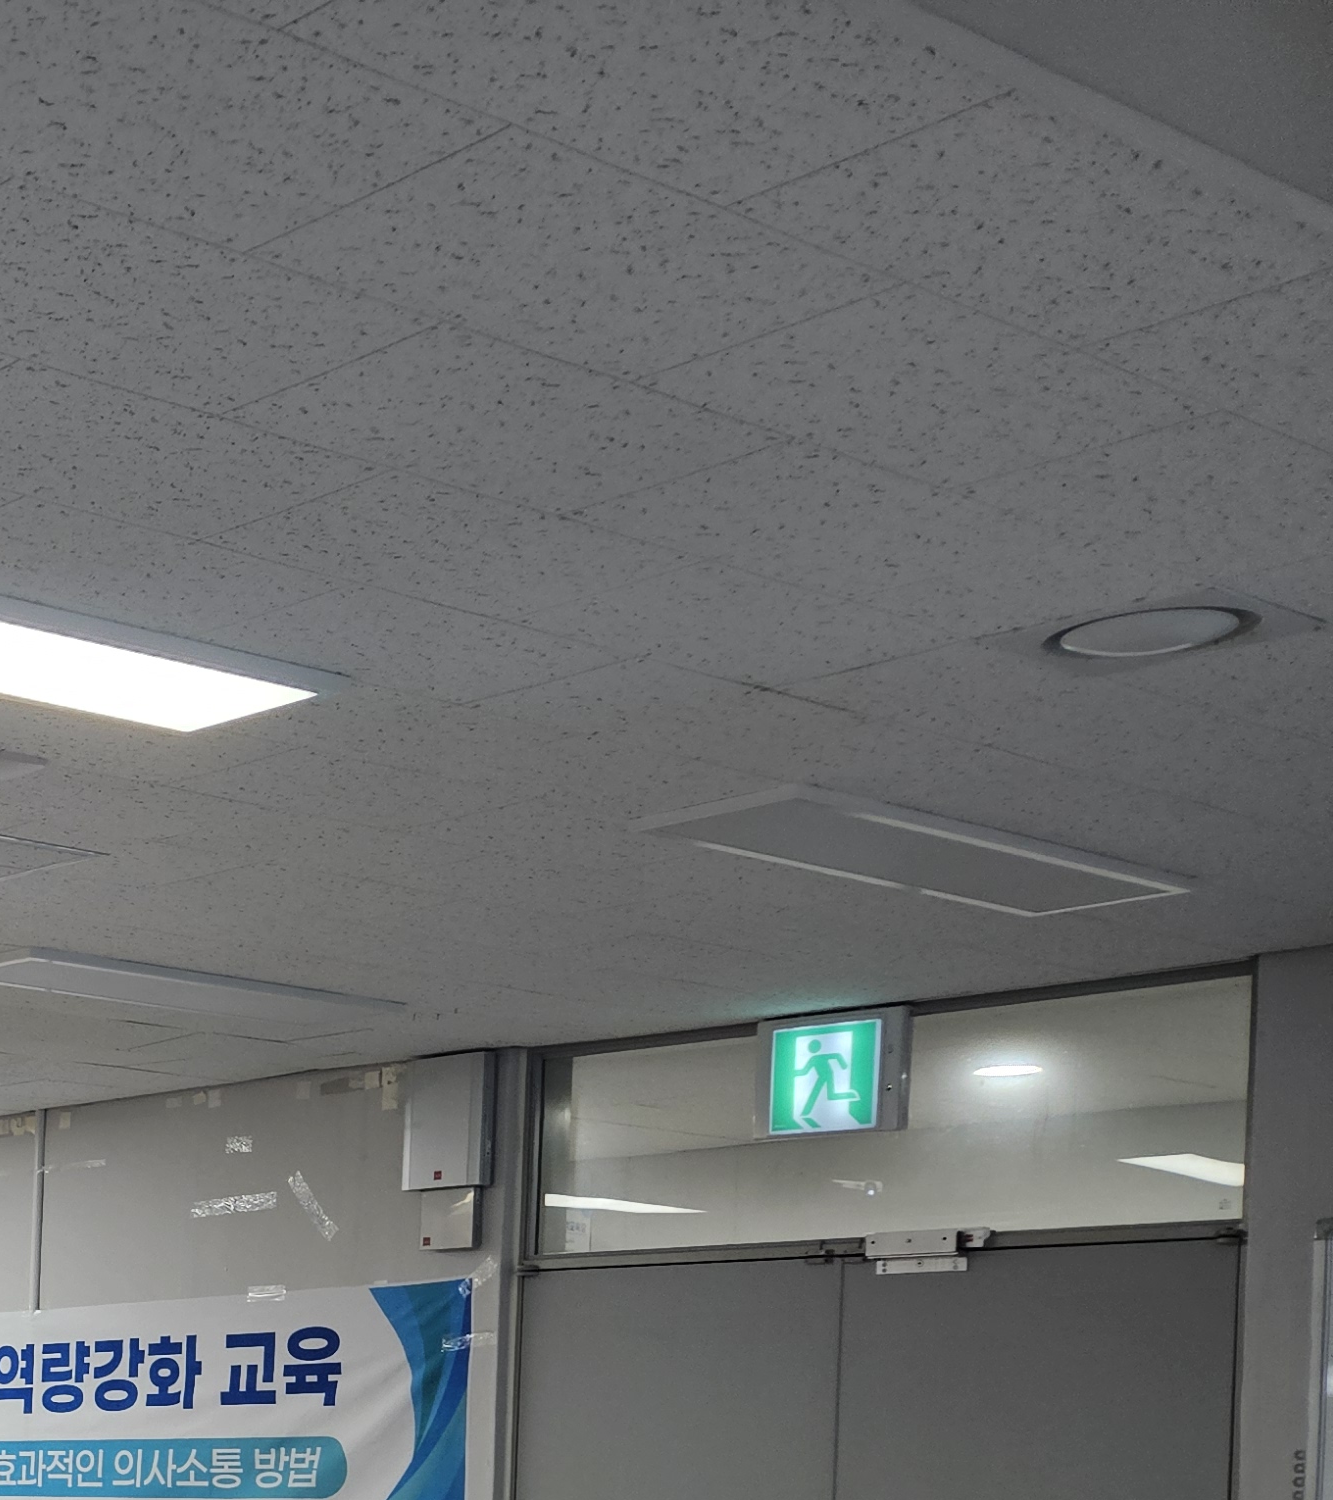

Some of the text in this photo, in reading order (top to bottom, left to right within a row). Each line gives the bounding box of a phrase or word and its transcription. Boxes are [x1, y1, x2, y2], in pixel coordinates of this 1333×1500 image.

[220, 1325, 343, 1408] 교육
[113, 1447, 244, 1490] 의사소통
[254, 1446, 323, 1489] 방법
